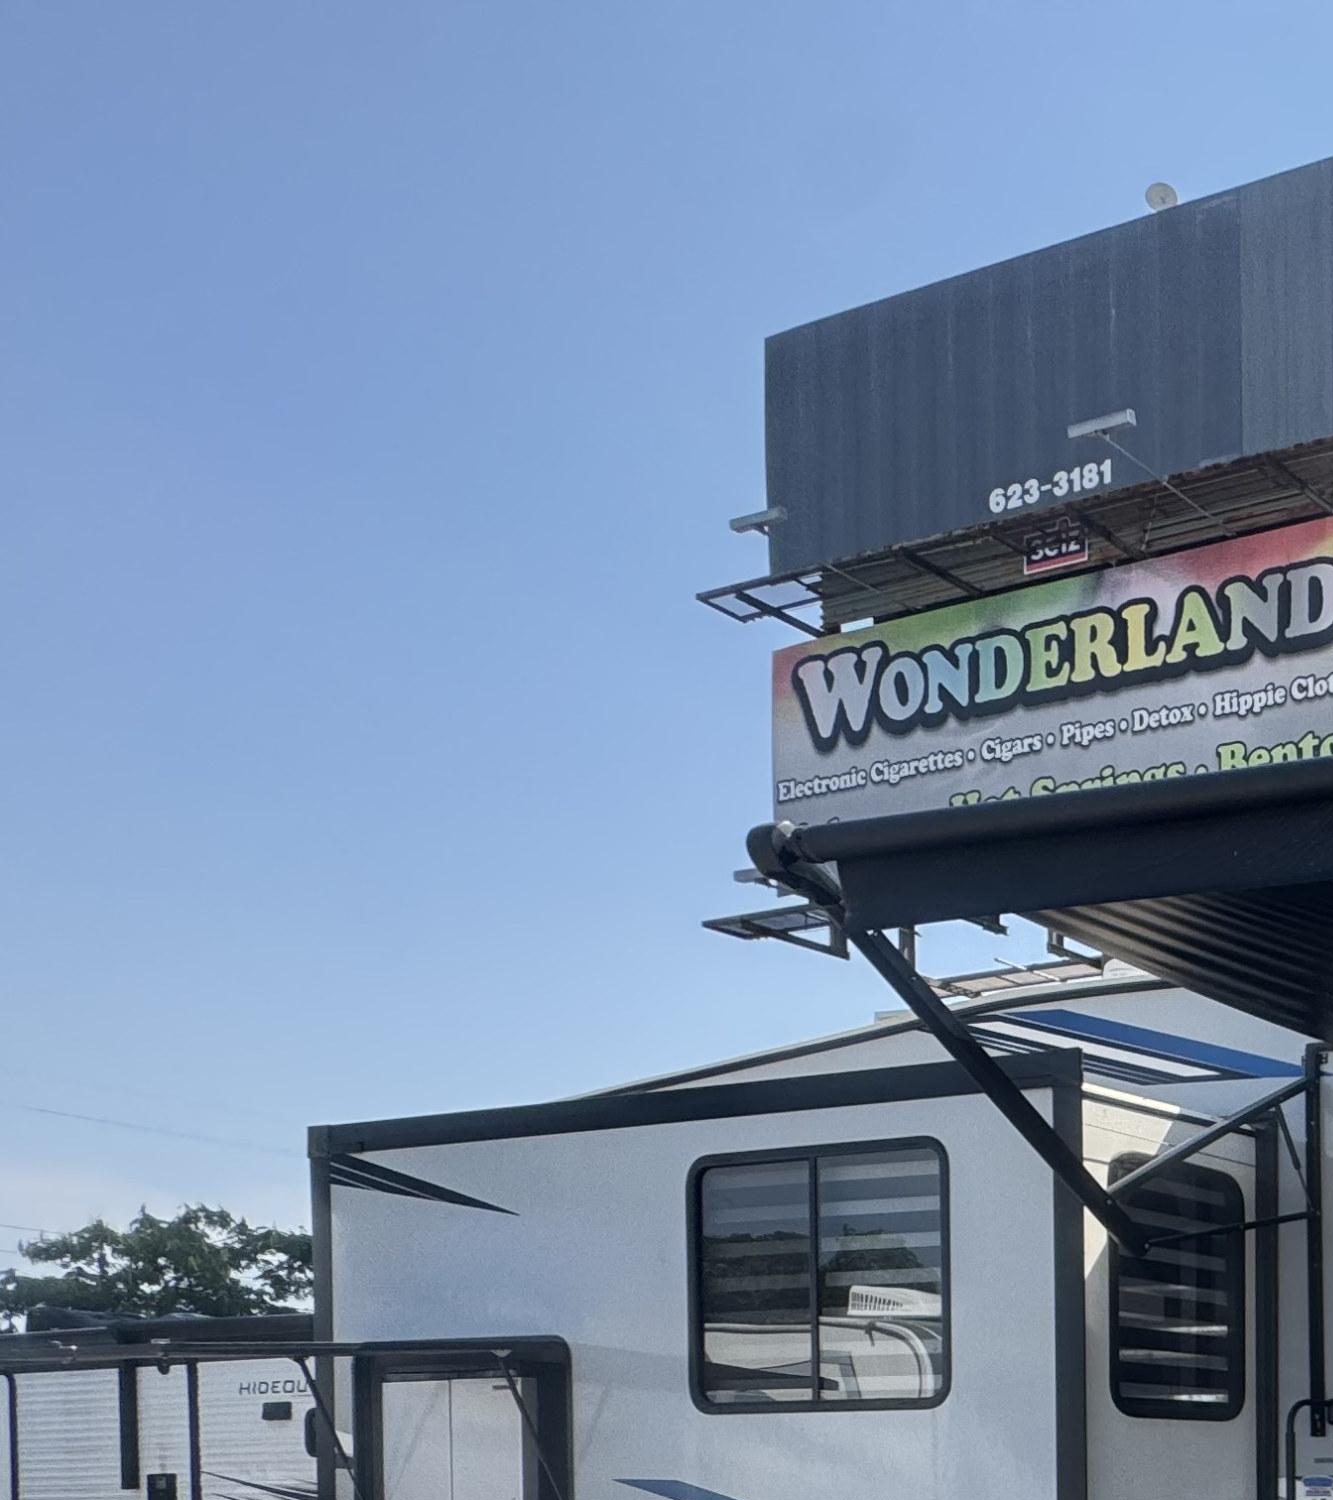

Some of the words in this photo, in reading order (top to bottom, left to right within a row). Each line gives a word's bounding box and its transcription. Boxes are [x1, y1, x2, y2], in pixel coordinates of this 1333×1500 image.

[988, 458, 1112, 513] 623-3181
[777, 767, 867, 801] Electronic
[870, 750, 963, 783] Cigarettes
[981, 734, 1043, 762] Cigars
[1061, 717, 1116, 746] Pipes
[1132, 703, 1195, 732] Detox
[1213, 683, 1287, 716] Hippie
[239, 1379, 315, 1396] HIDEOU
